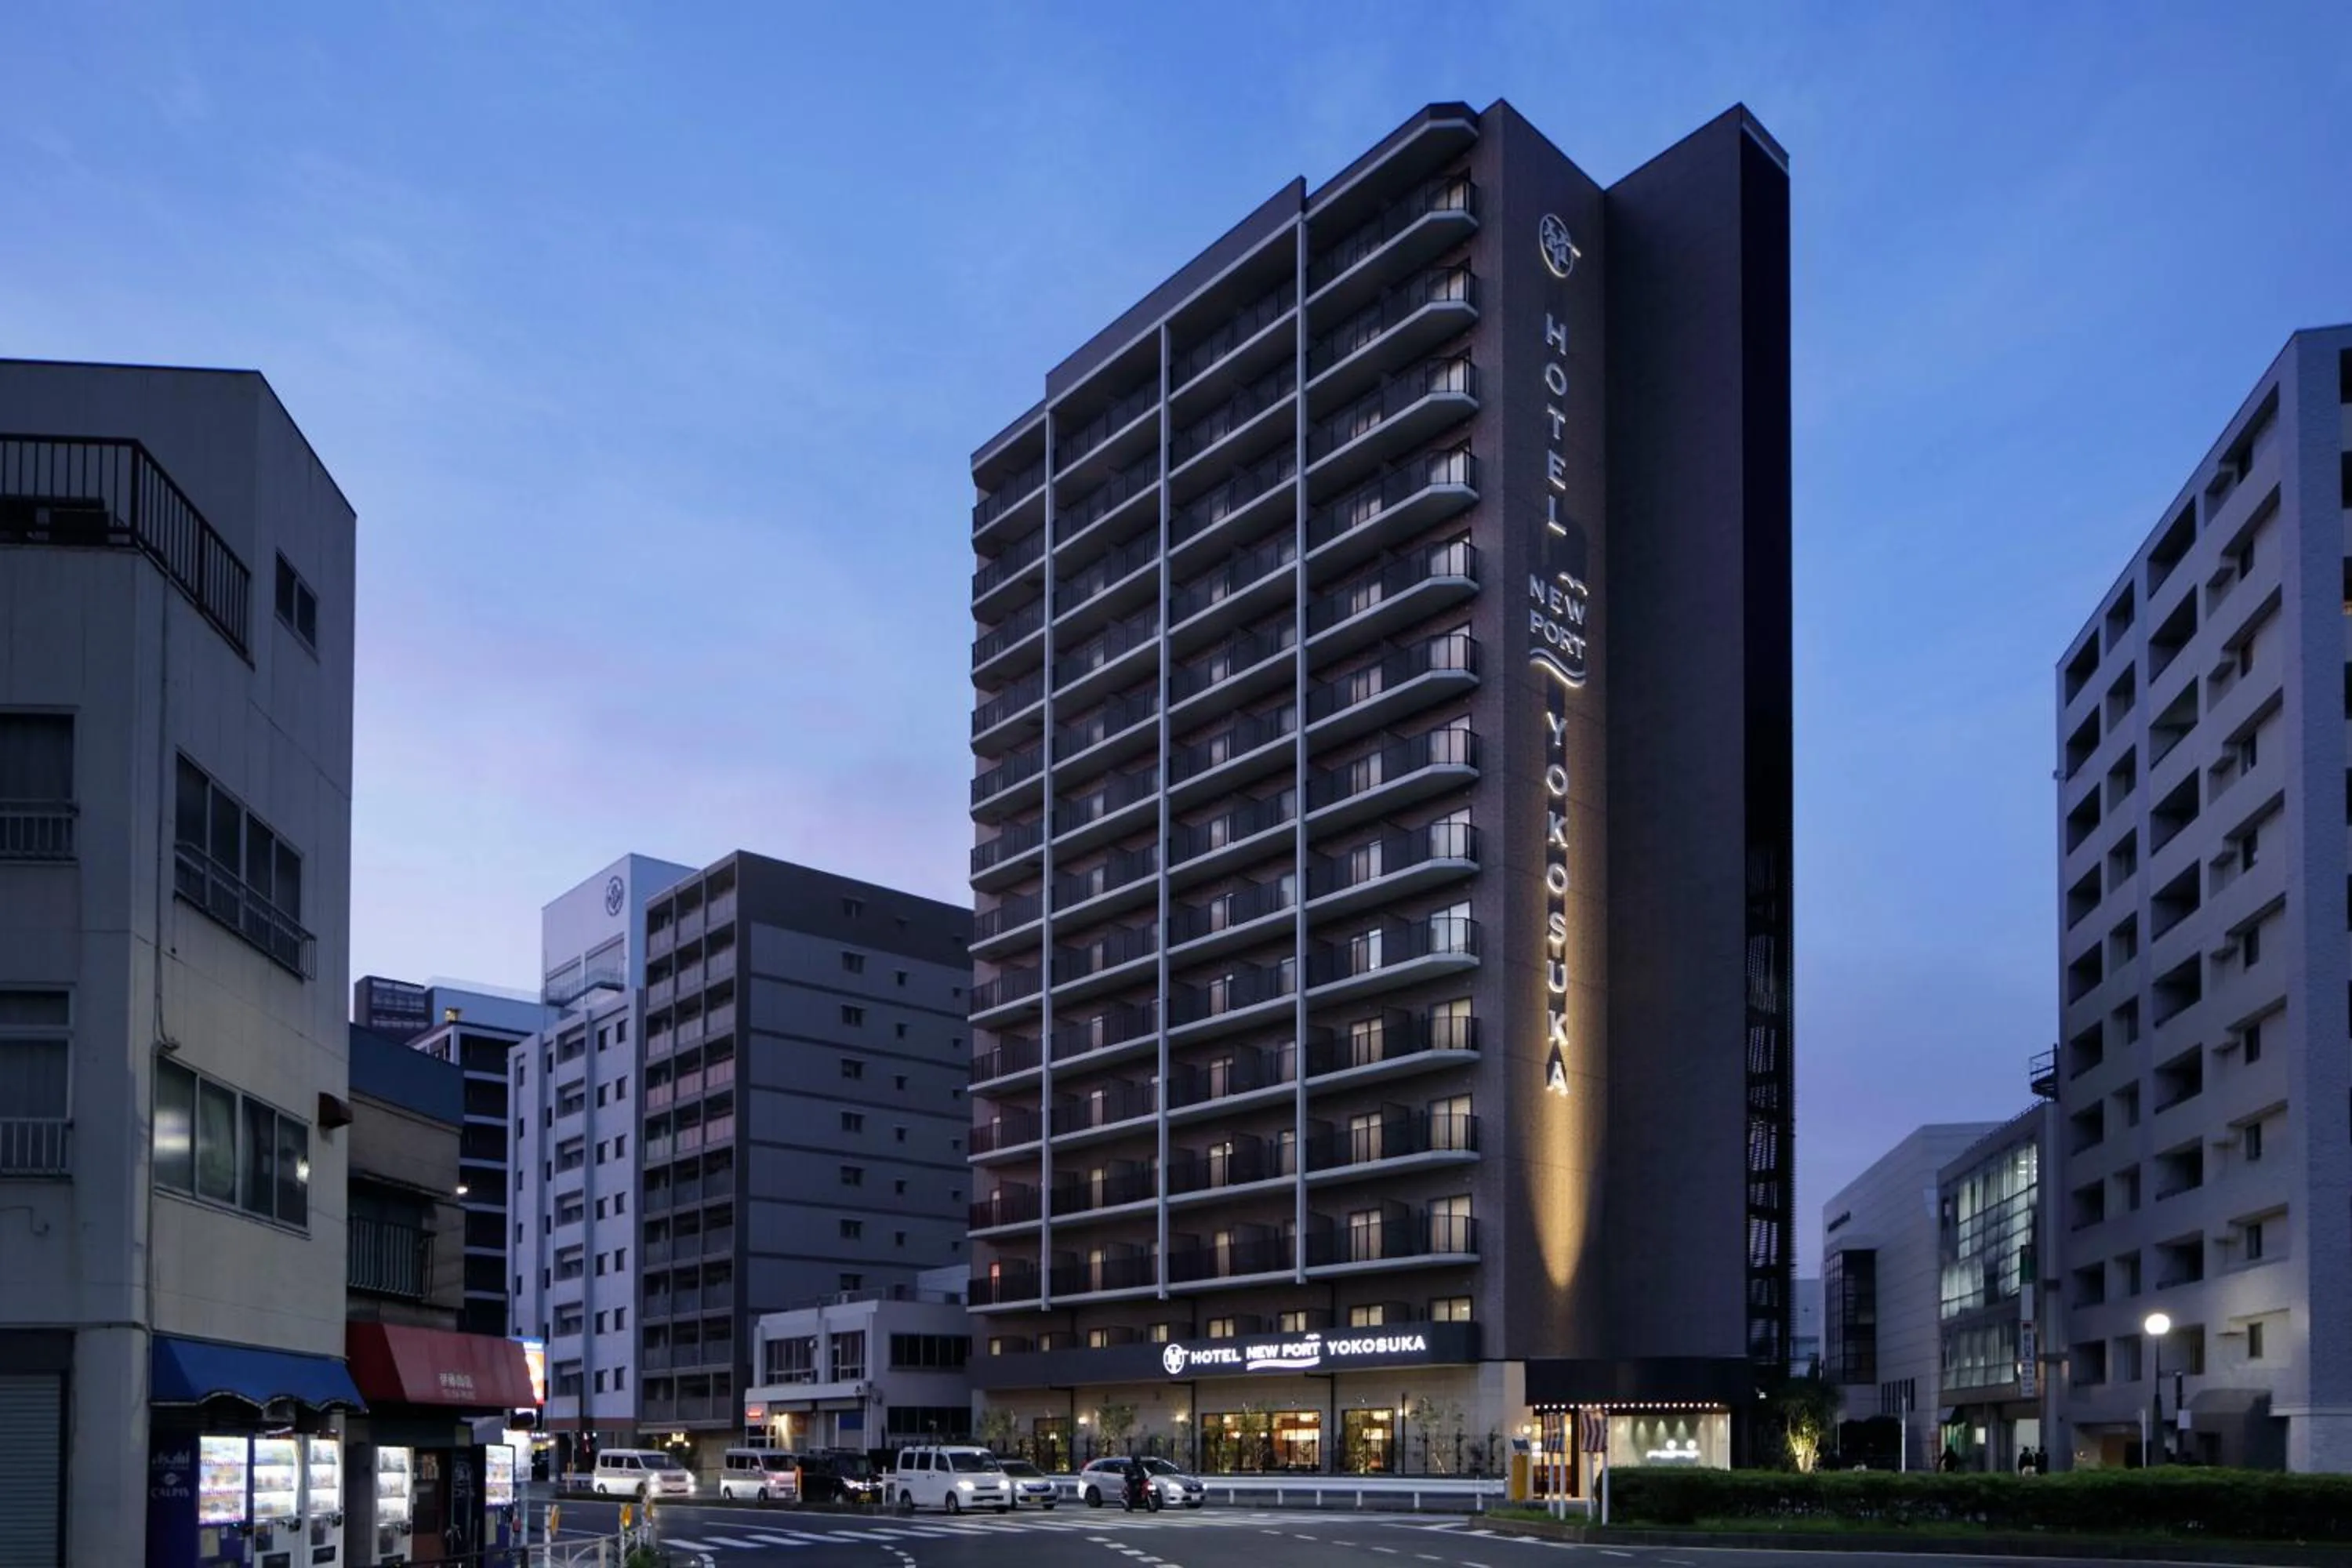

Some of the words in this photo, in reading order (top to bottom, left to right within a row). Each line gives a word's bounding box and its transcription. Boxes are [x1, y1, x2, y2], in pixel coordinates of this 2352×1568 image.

[1545, 313, 1568, 536] HOTEL
[1529, 573, 1586, 626] NEW
[1529, 608, 1587, 659] PORT
[1546, 710, 1569, 1096] YOKOSUKA
[1190, 1347, 1241, 1365] HOTEL
[1246, 1343, 1279, 1359] NEW
[1282, 1341, 1321, 1358] PORT
[1327, 1334, 1427, 1356] YOKOSUKA
